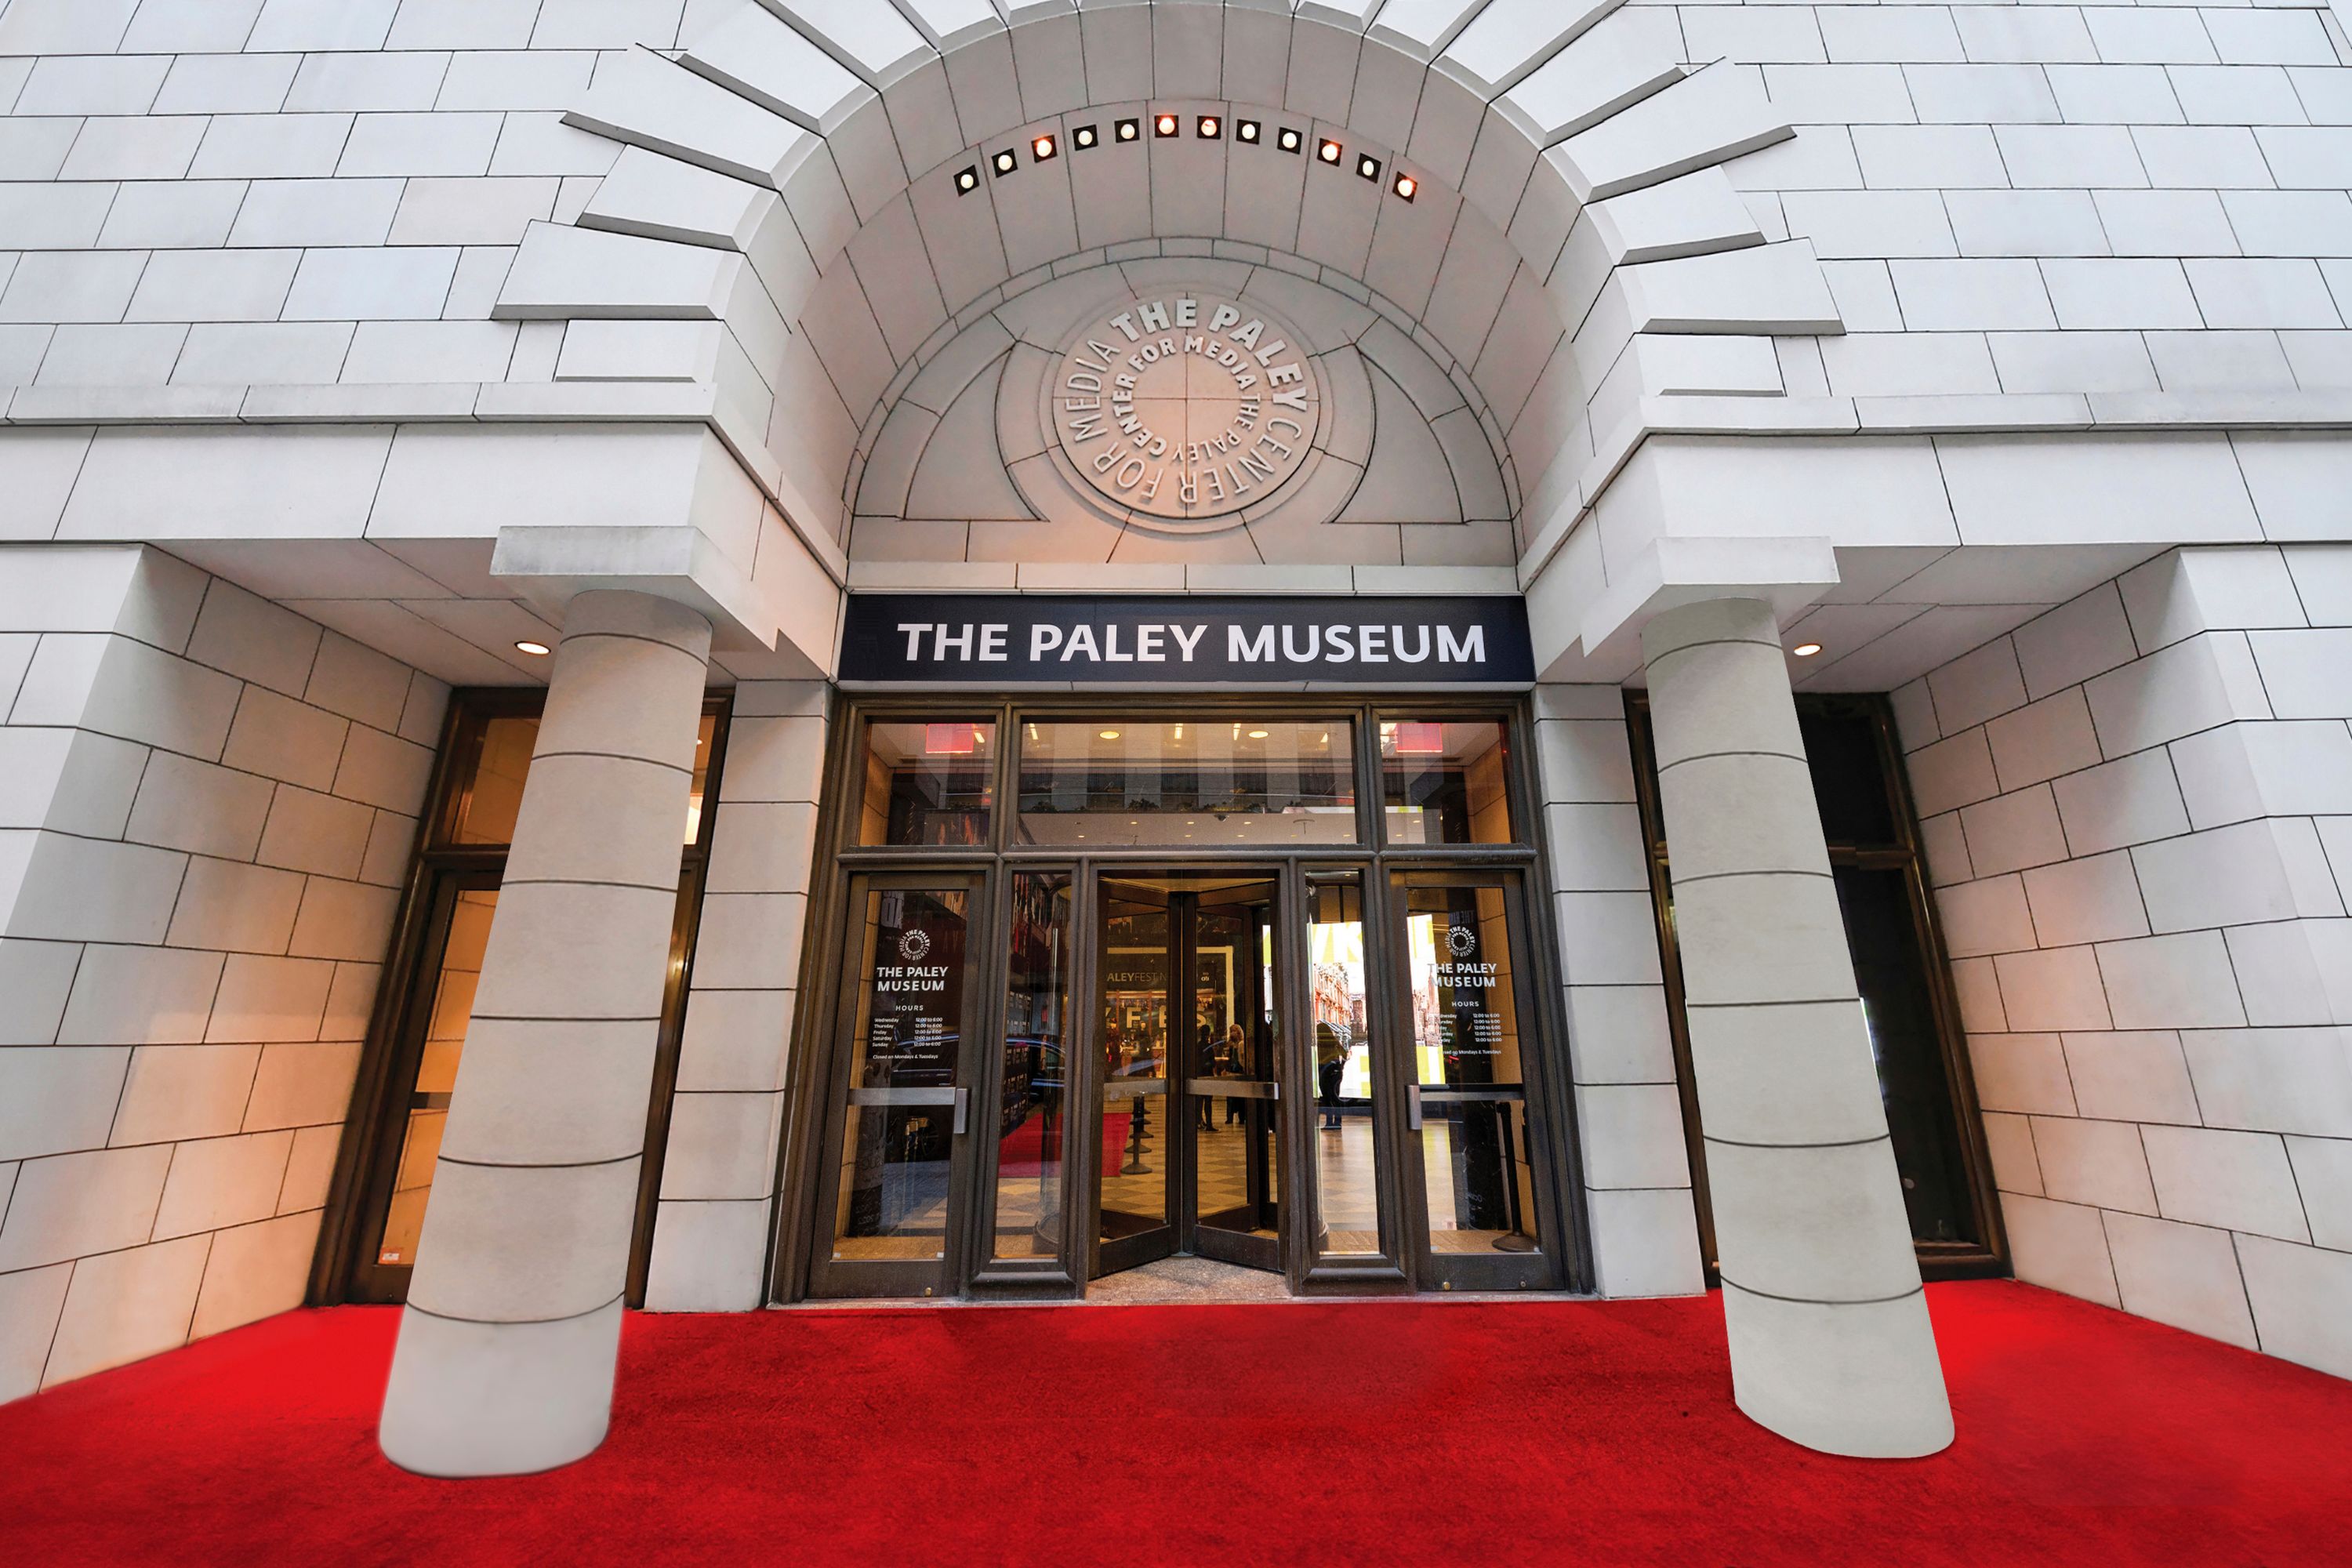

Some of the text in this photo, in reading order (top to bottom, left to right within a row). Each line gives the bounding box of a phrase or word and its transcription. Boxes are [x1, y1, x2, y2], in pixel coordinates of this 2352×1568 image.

[1065, 299, 1308, 503] THE PALEY CENTER FOR MEDIA
[1112, 335, 1261, 462] CENTER FOR MEDIA THE PALEY
[898, 623, 1486, 663] THE PALEY MUSEUM
[877, 966, 949, 978] THE PALEY
[1427, 963, 1497, 975] THE PALEY
[877, 981, 945, 992] MUSEUM
[1431, 976, 1497, 988] MUSEUM
